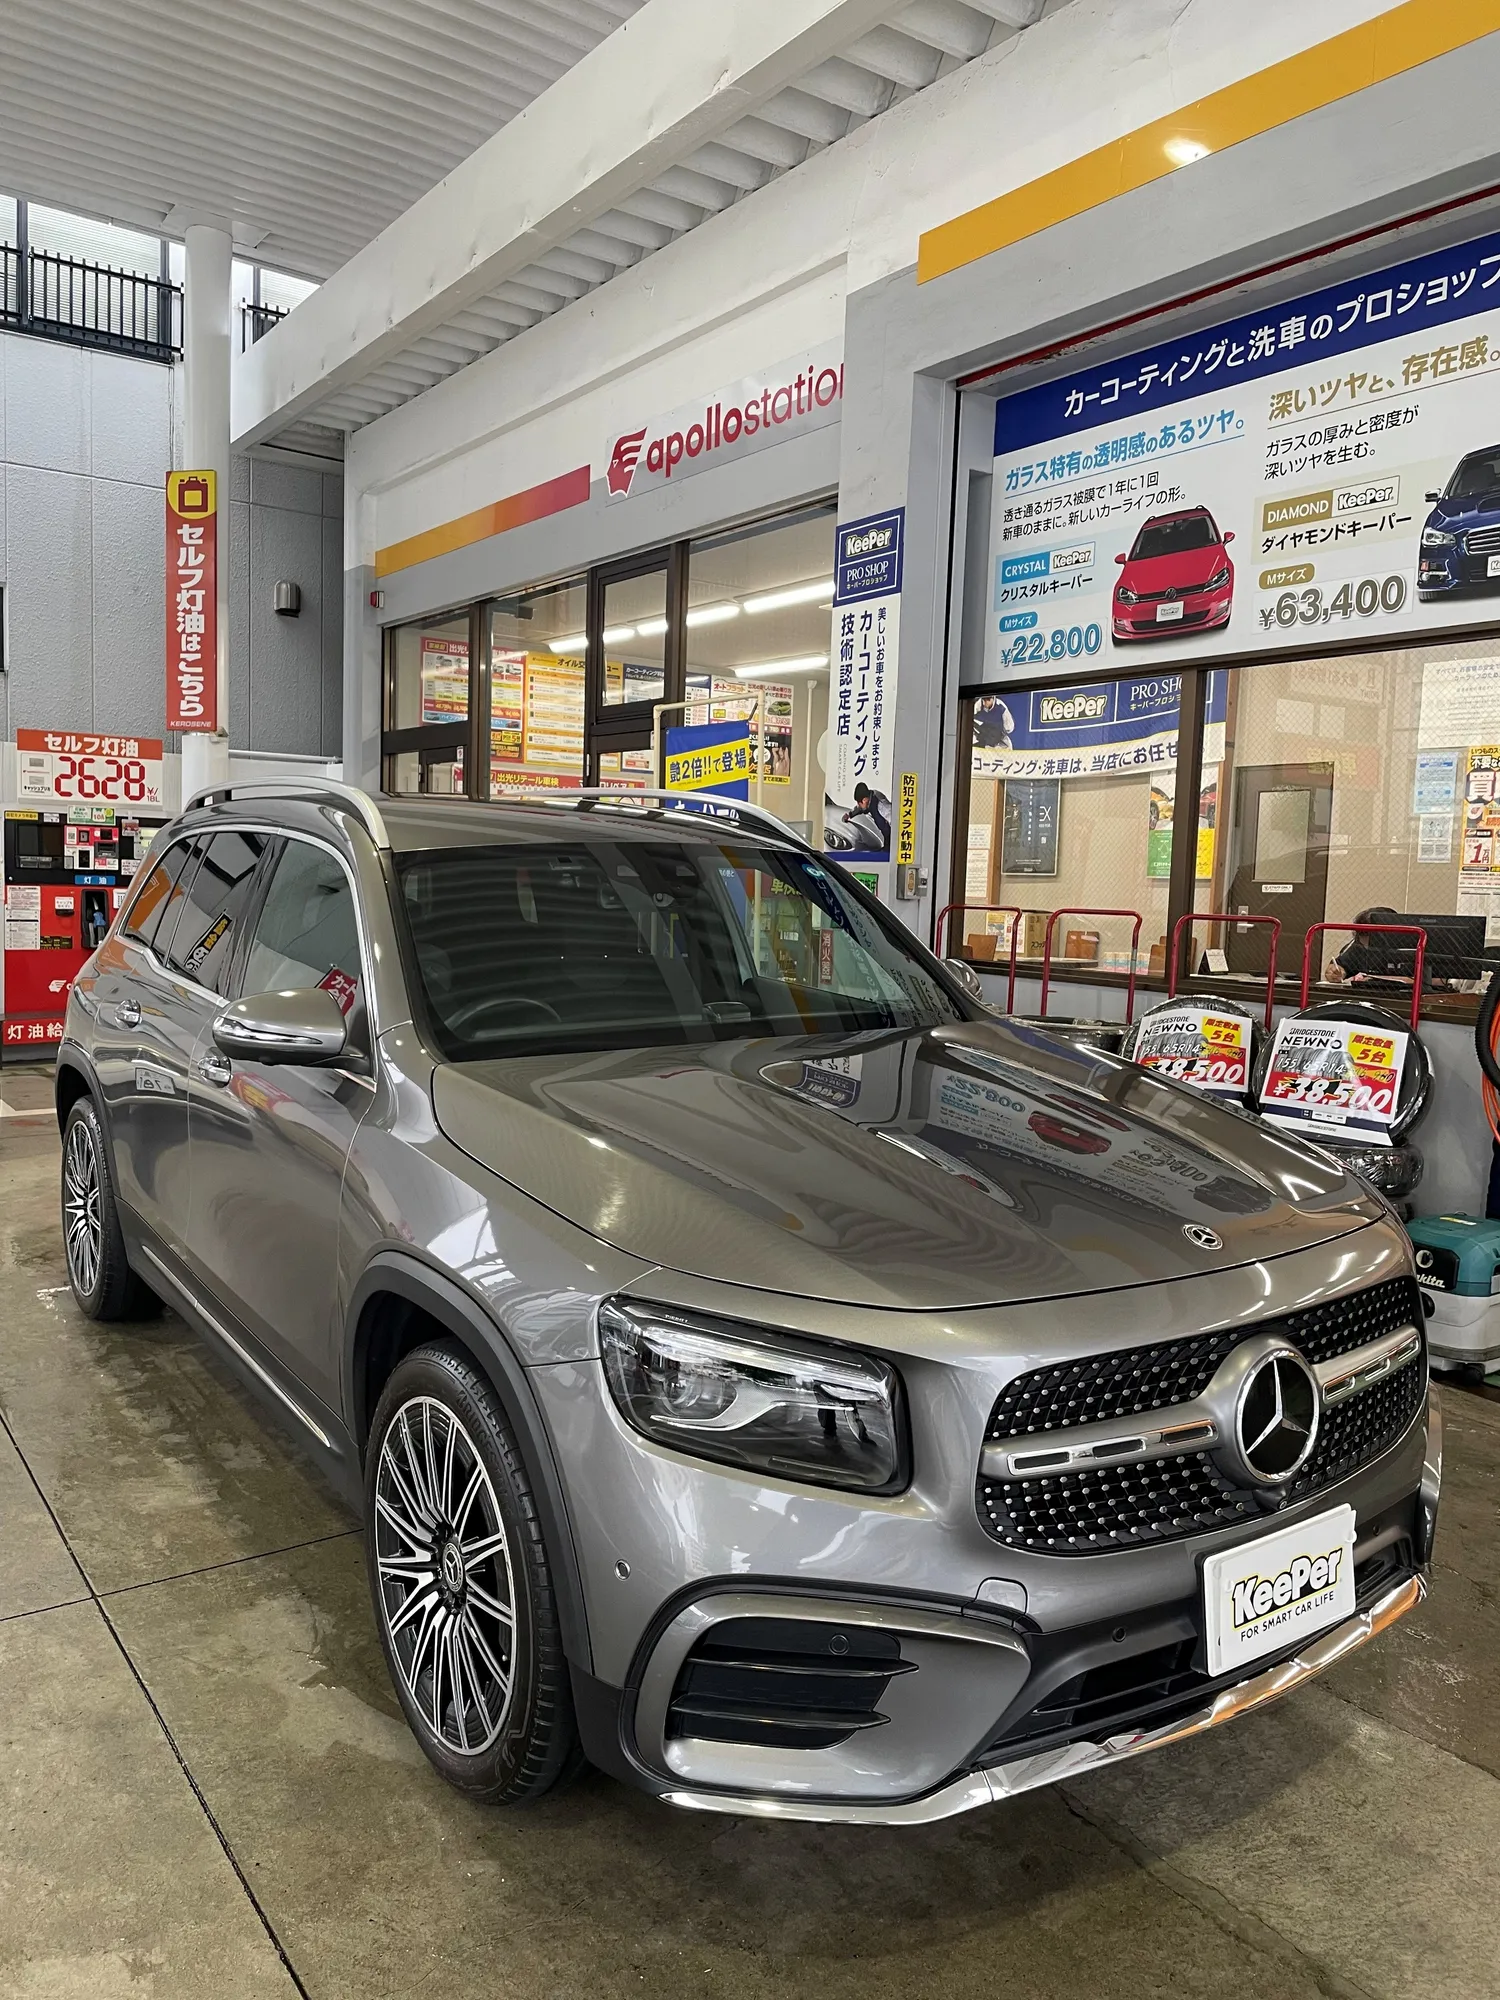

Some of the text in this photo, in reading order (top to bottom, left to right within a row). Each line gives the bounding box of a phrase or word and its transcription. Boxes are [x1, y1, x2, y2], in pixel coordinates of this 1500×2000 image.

[646, 362, 844, 478] apollostatio
[1266, 404, 1419, 458] ガラスの厚みと密度が
[1005, 408, 1244, 491] ガラス特有の透明感のあるツヤ。
[1264, 441, 1376, 480] 深いツヤを生む。
[1003, 471, 1160, 523] 透き通るガラス被膜で1年に1回
[1267, 487, 1394, 524] DIAMOND KeePer
[1002, 485, 1187, 541] 新車のままに。新しいカーライフの形。
[845, 528, 892, 557] KeePer
[1261, 512, 1412, 554] ダイヤモンドキーパー
[846, 560, 889, 582] PRO SHOP
[1004, 548, 1091, 577] CRYSTAL KeePer
[1266, 568, 1307, 584] Mサイズ
[1001, 575, 1093, 602] クリスタルキーパー
[1258, 574, 1407, 629] ¥63,400
[176, 523, 205, 717] セルフ灯油はこちら
[1004, 616, 1033, 629] Mサイズ
[1001, 623, 1102, 667] ¥22,800
[837, 612, 856, 737] 技術認定店
[854, 610, 873, 777] カーコーティング
[871, 607, 887, 776] 美しいお車をお約束します。
[1130, 680, 1158, 701] PRO
[1040, 693, 1108, 723] KeePer
[170, 720, 211, 728] KEROSENE
[44, 733, 139, 757] セルフ灯油
[1471, 747, 1500, 755] いつものス
[1471, 756, 1500, 769] 不要な
[55, 755, 145, 801] 2628
[497, 773, 559, 786] 出光リテール車検
[900, 775, 915, 863] 防犯カメラ作動中
[83, 876, 107, 885] 灯油
[822, 933, 831, 976] 消火器
[1143, 1023, 1197, 1037] NEWNO
[1205, 1018, 1241, 1031] 限定数量
[1211, 1030, 1235, 1043] 5台
[1289, 1027, 1336, 1037] BRIDGESTONE
[1281, 1036, 1342, 1049] NEWNO
[1352, 1034, 1393, 1050] 限定数量
[1357, 1049, 1386, 1064] 5台
[1416, 1273, 1446, 1289] akita
[1232, 1547, 1342, 1628] KeePer
[1240, 1591, 1334, 1642] FOR SMART CAR LIFE
